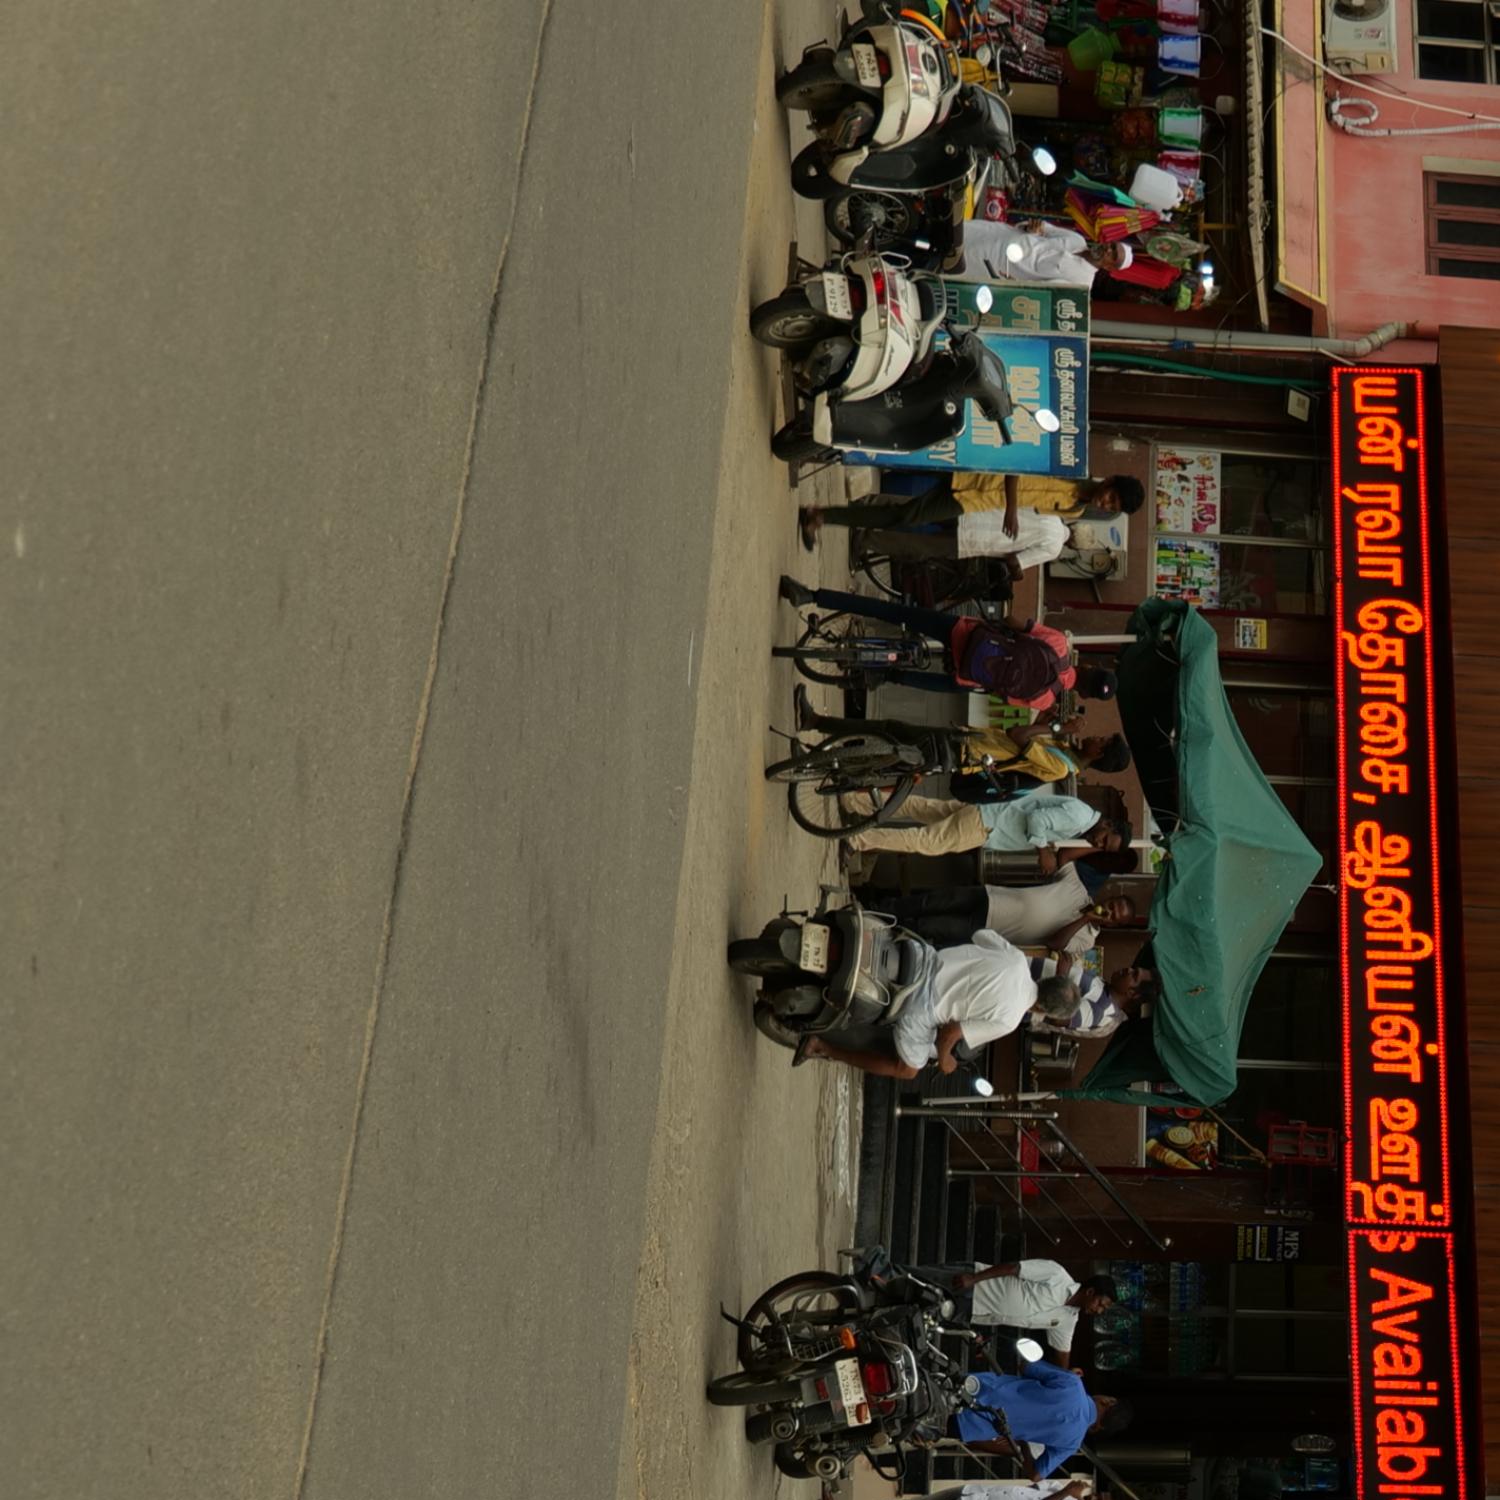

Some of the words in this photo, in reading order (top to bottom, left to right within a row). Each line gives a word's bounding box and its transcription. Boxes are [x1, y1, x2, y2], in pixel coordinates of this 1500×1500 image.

[1353, 376, 1418, 470] யன்
[1342, 482, 1403, 586] ரவா
[1344, 820, 1438, 1083] ஆனியன்
[1284, 1230, 1300, 1259] MPS
